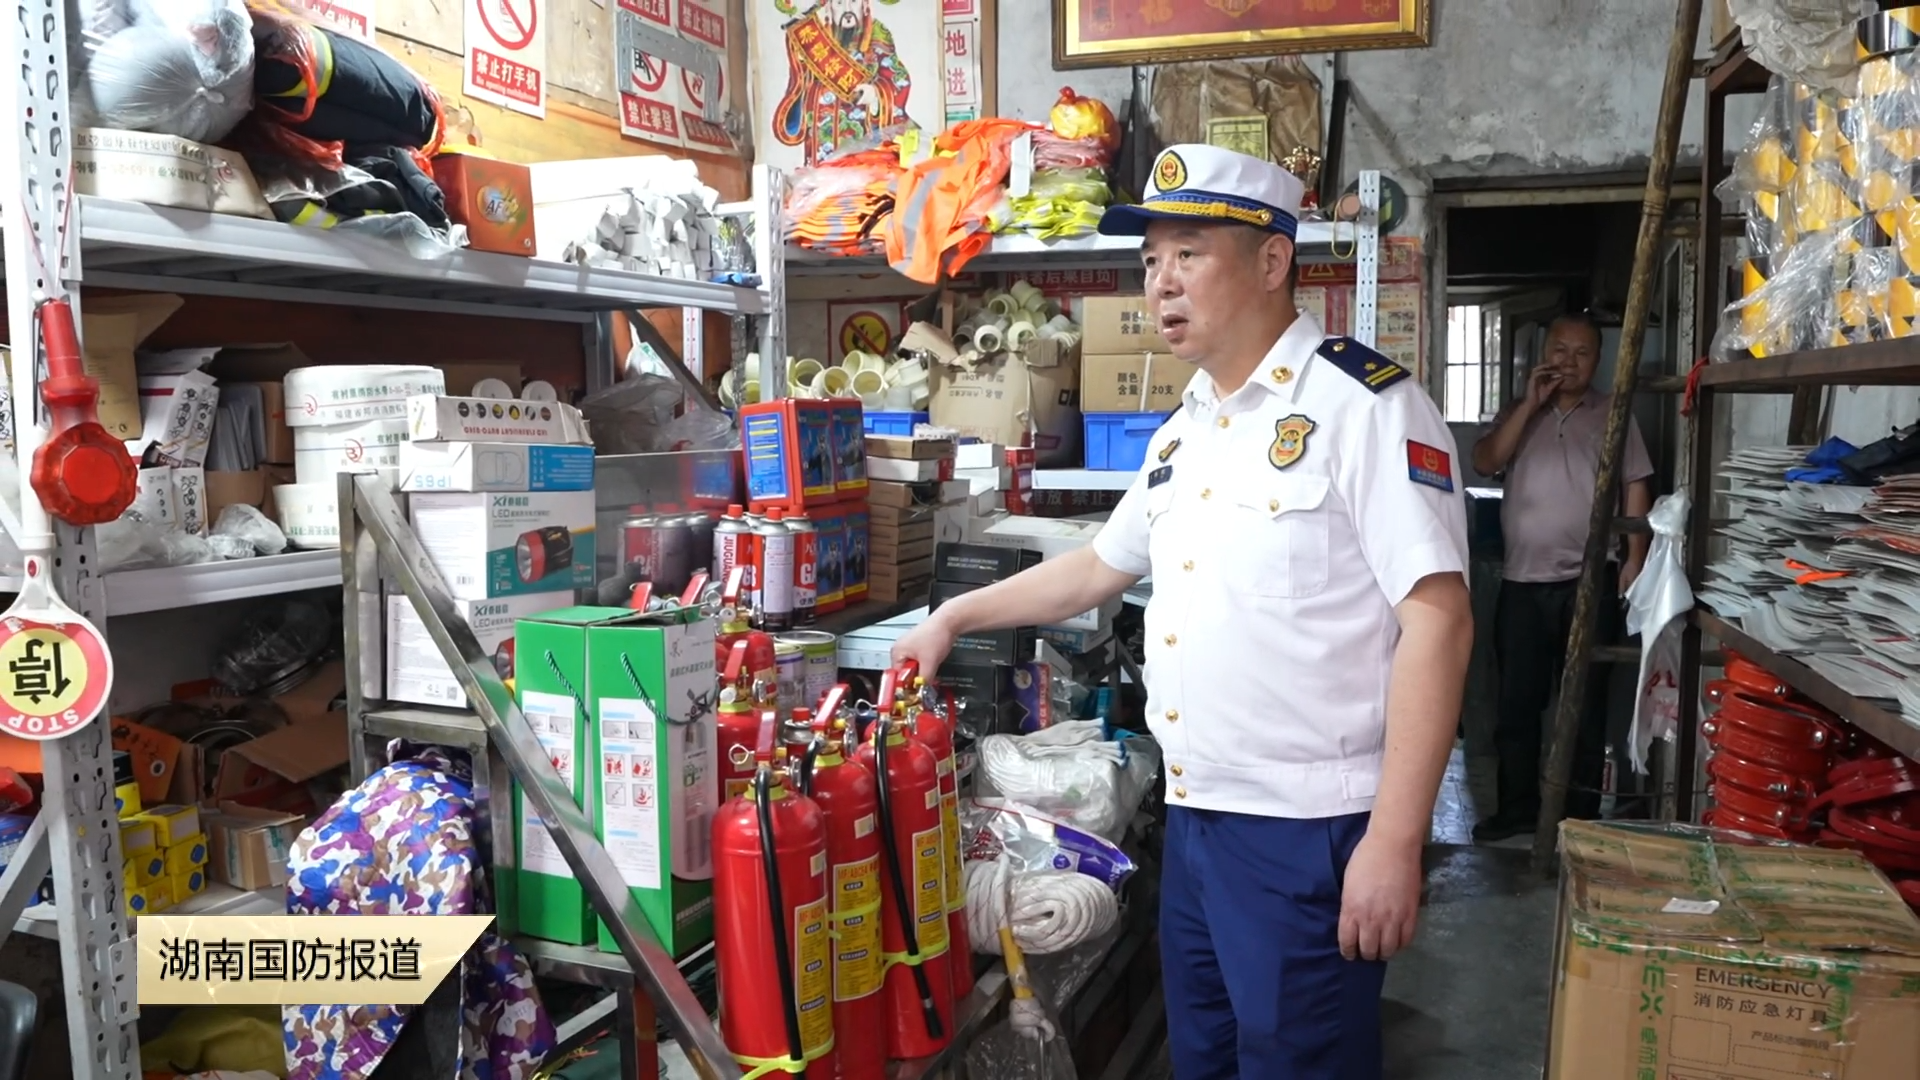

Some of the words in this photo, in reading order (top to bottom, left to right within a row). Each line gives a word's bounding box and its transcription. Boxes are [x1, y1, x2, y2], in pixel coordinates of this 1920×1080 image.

[476, 52, 537, 91] 禁止打手机
[1151, 385, 1174, 395] 20支
[414, 475, 451, 488] IP65
[492, 509, 510, 518] LED
[722, 536, 734, 584] JIUGUANG
[473, 617, 490, 628] LED
[9, 639, 72, 705] 停
[8, 709, 79, 732] STOP
[1695, 967, 1832, 1000] EMERGENCY
[1693, 991, 1828, 1025] 消防应急灯具
